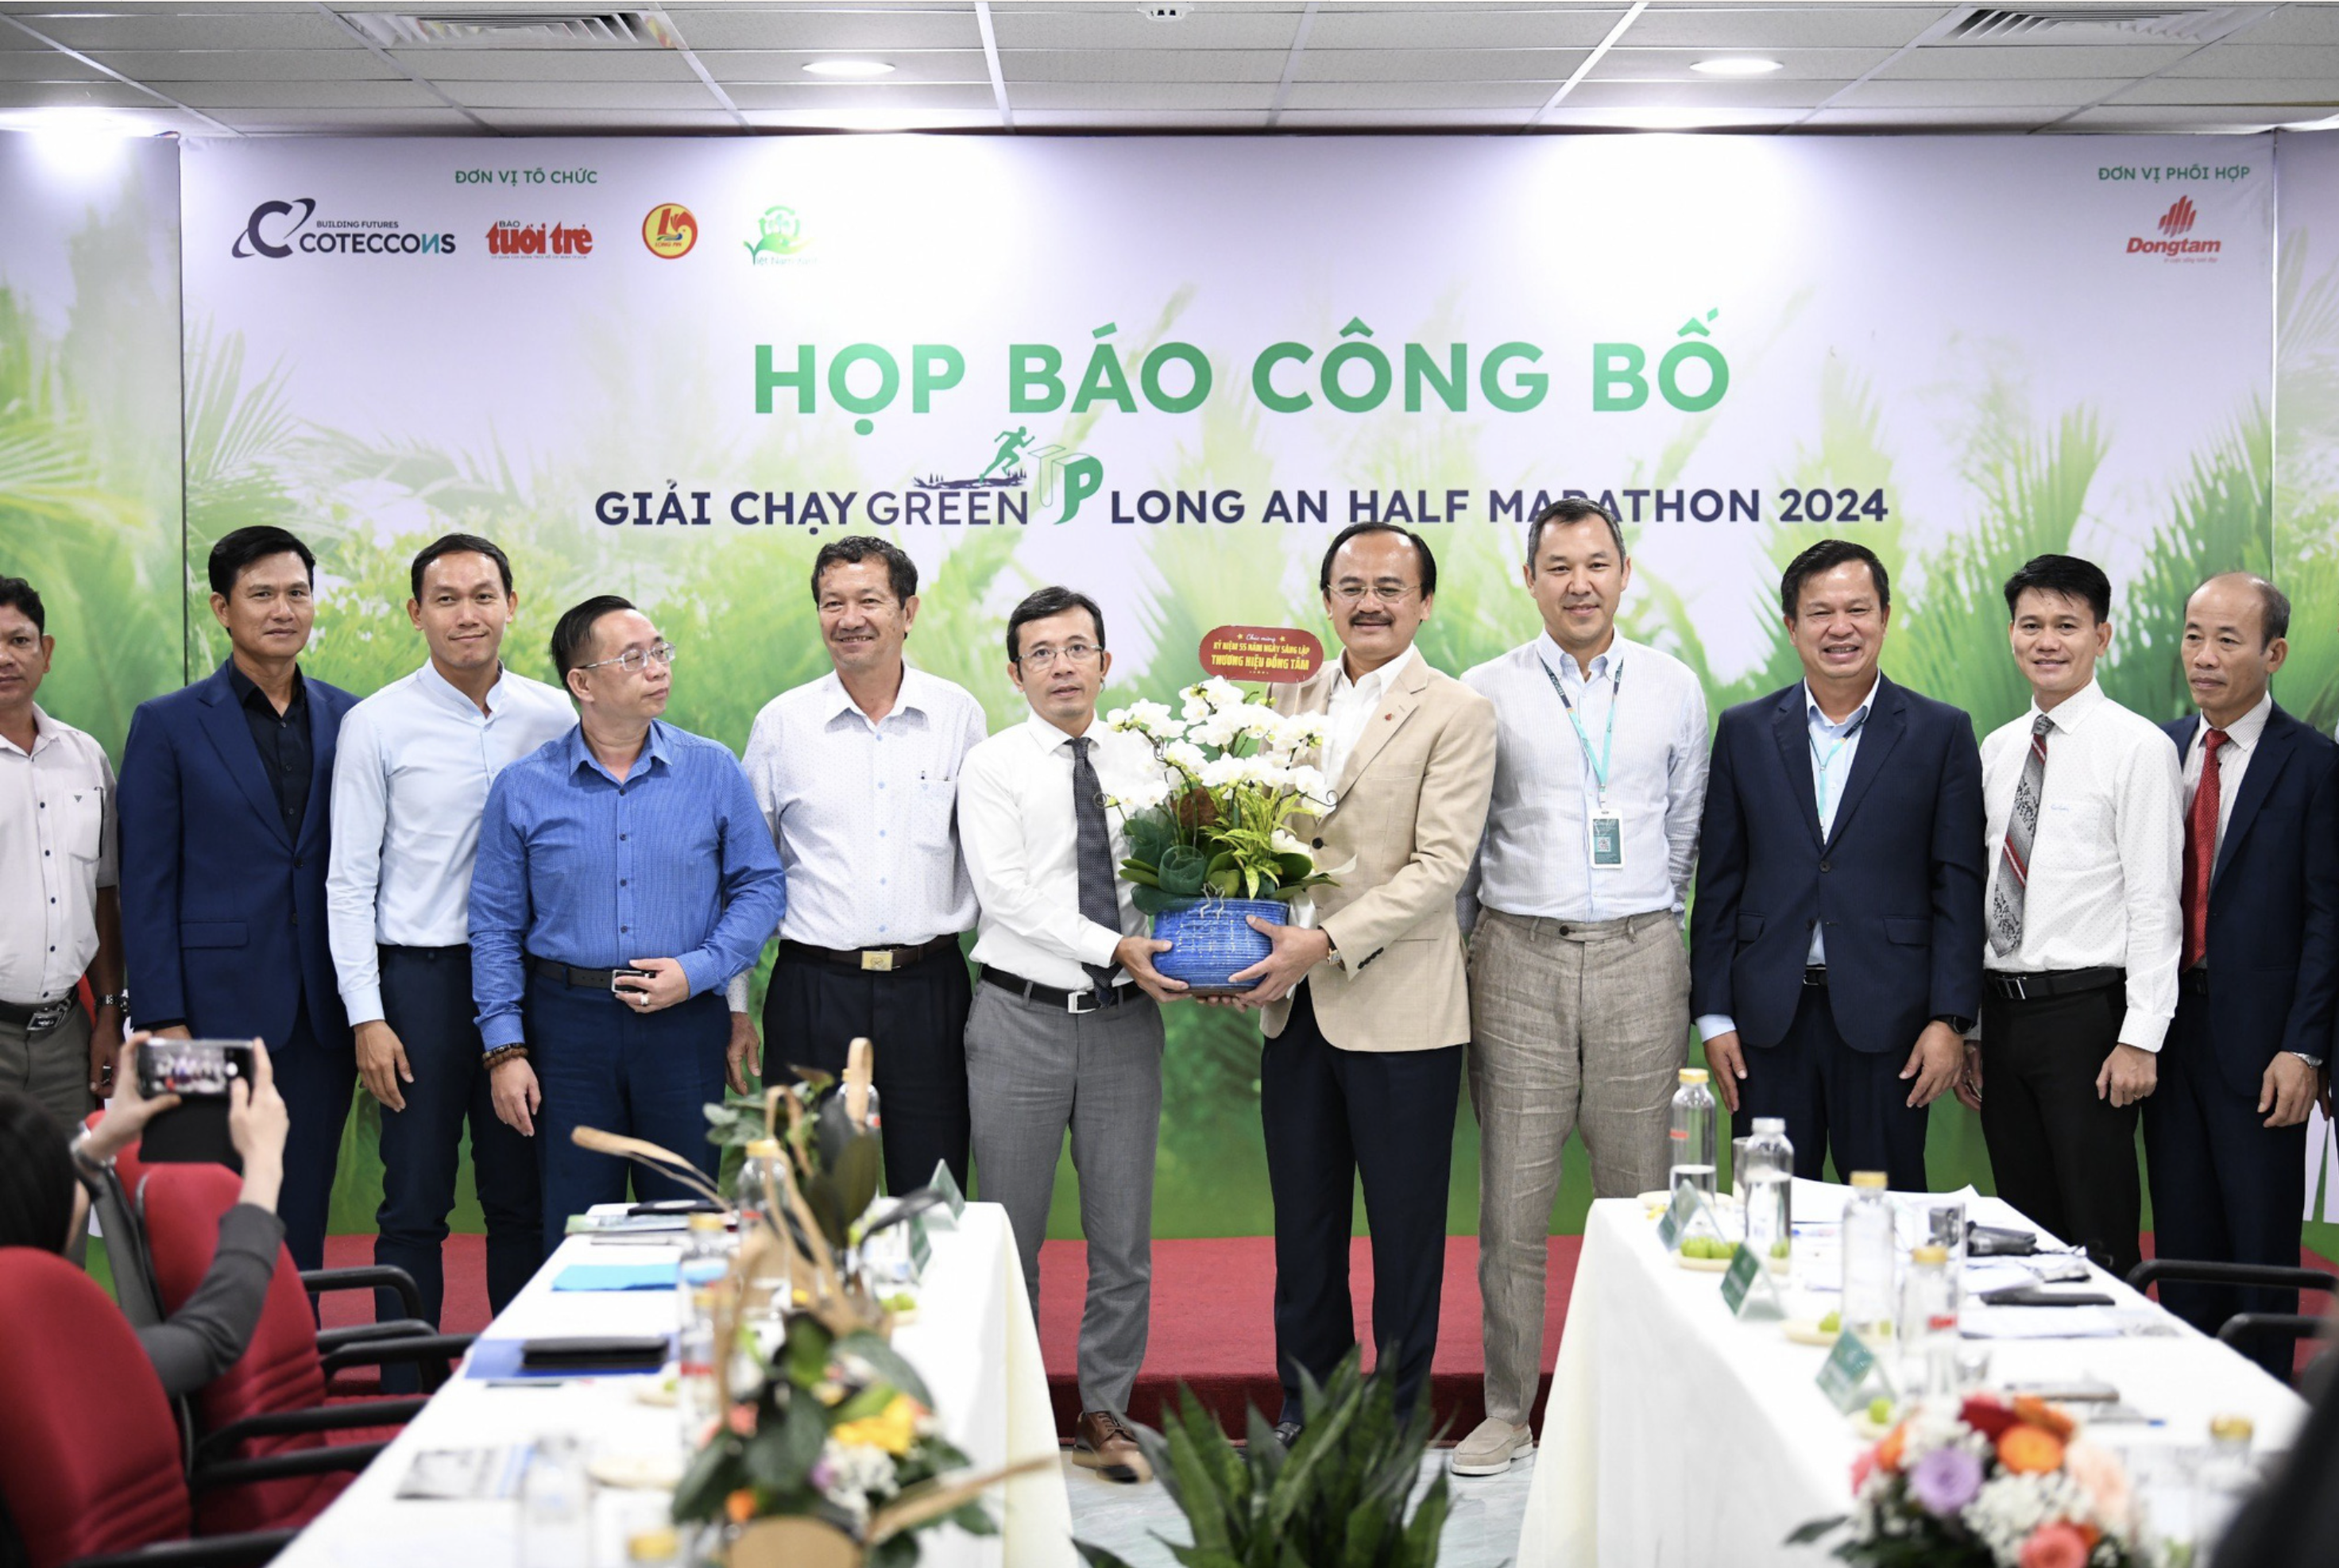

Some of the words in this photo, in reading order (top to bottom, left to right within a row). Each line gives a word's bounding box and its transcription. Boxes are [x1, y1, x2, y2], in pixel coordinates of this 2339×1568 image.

[454, 169, 493, 183] ĐƠN
[498, 170, 518, 187] VỊ
[551, 168, 597, 183] CHỨC
[2098, 165, 2136, 180] ĐƠN
[2141, 167, 2160, 183] VỊ
[2215, 164, 2251, 183] HỢP
[2126, 238, 2221, 257] Dongtam
[755, 342, 965, 435] HỌP
[1008, 322, 1212, 414] BÁO
[1252, 316, 1549, 413] CÔNG
[1592, 307, 1730, 413] BỐ
[595, 479, 711, 525] GIẢI
[730, 491, 857, 535] CHẠY
[867, 490, 1028, 525] GREEN
[1111, 490, 1246, 524] LONG
[1262, 490, 1328, 523] AN
[1349, 489, 1469, 523] HALF
[1489, 489, 1760, 523] MAATHON
[1780, 489, 1889, 523] 2024
[1222, 639, 1239, 652] NIỆM
[1239, 643, 1247, 651] 55
[1263, 643, 1281, 654] NGÀY
[1281, 643, 1298, 655] SÁNG
[1298, 644, 1310, 656] LẬP
[1212, 654, 1244, 666] THƯƠNG
[1245, 654, 1265, 670] HIỆU
[1290, 656, 1309, 670] TÂM
